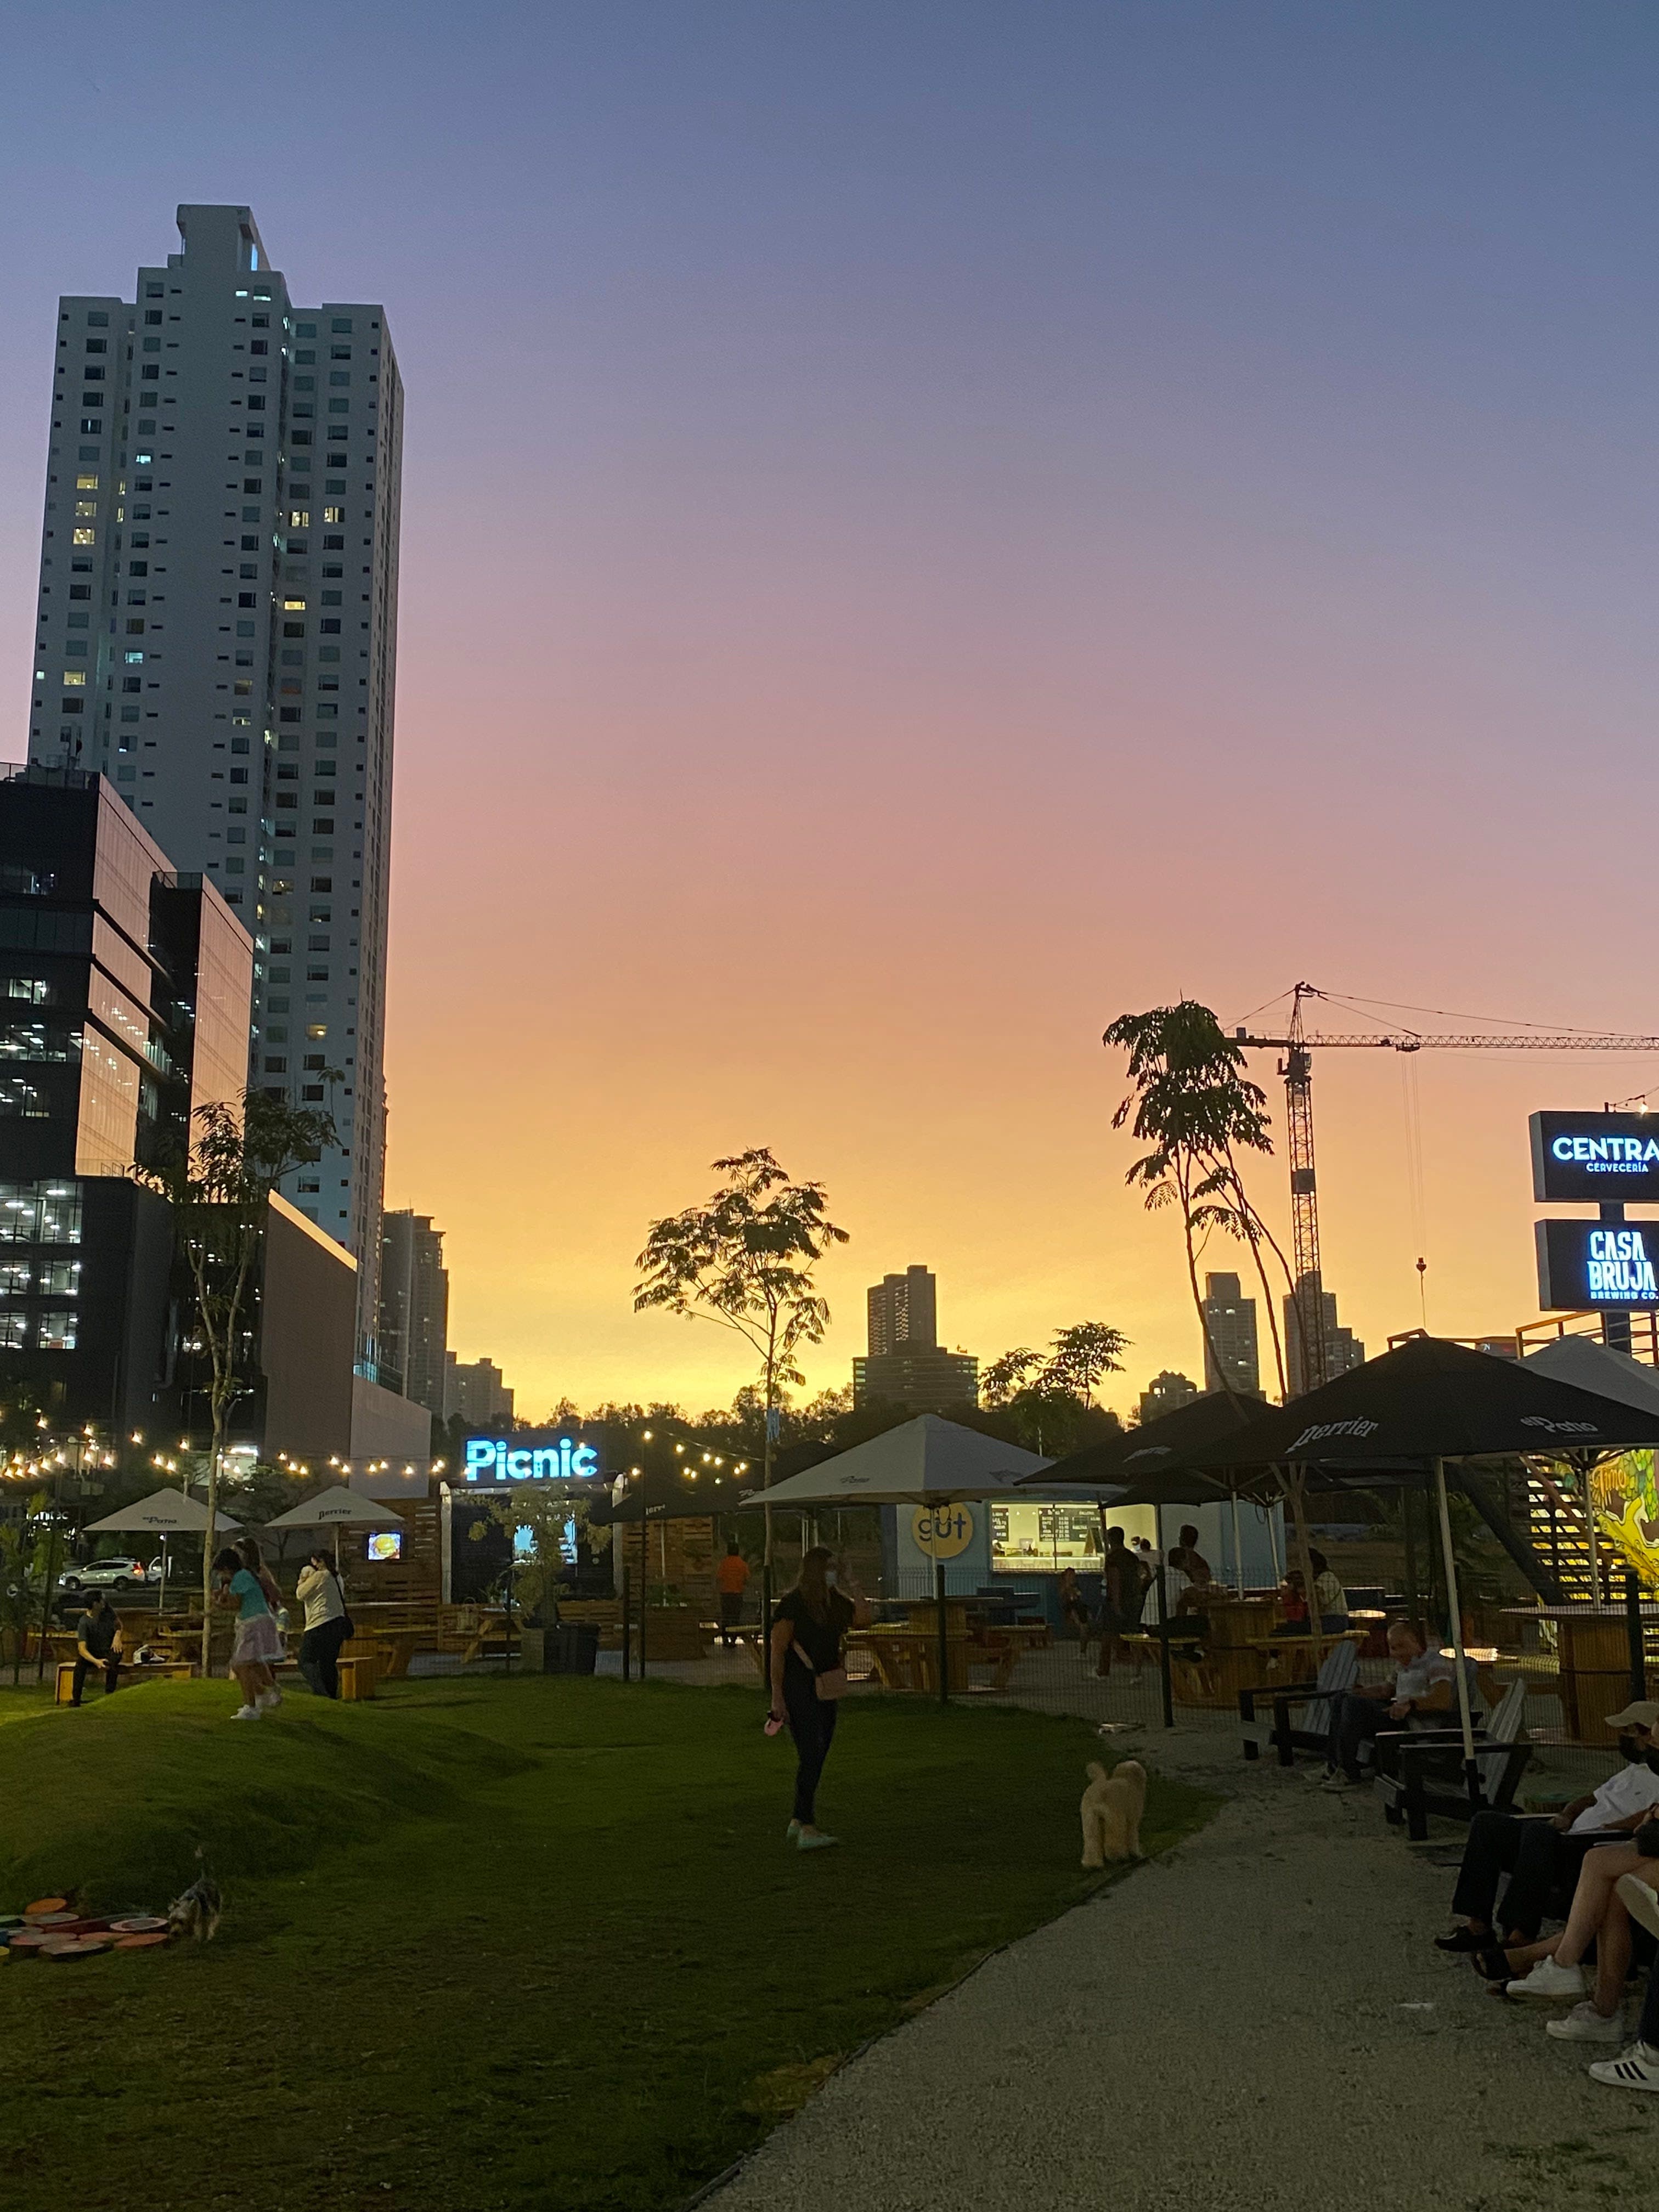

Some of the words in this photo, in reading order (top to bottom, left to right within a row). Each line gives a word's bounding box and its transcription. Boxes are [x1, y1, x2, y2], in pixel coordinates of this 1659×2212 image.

[1553, 1137, 1659, 1161] CENTRA
[1586, 1161, 1649, 1172] CERVECERÍA
[1590, 1231, 1646, 1261] CASA
[1587, 1261, 1658, 1291] BRUJA
[1590, 1291, 1638, 1300] BREWING
[1641, 1291, 1658, 1300] CO.
[466, 1438, 597, 1481] Picnic
